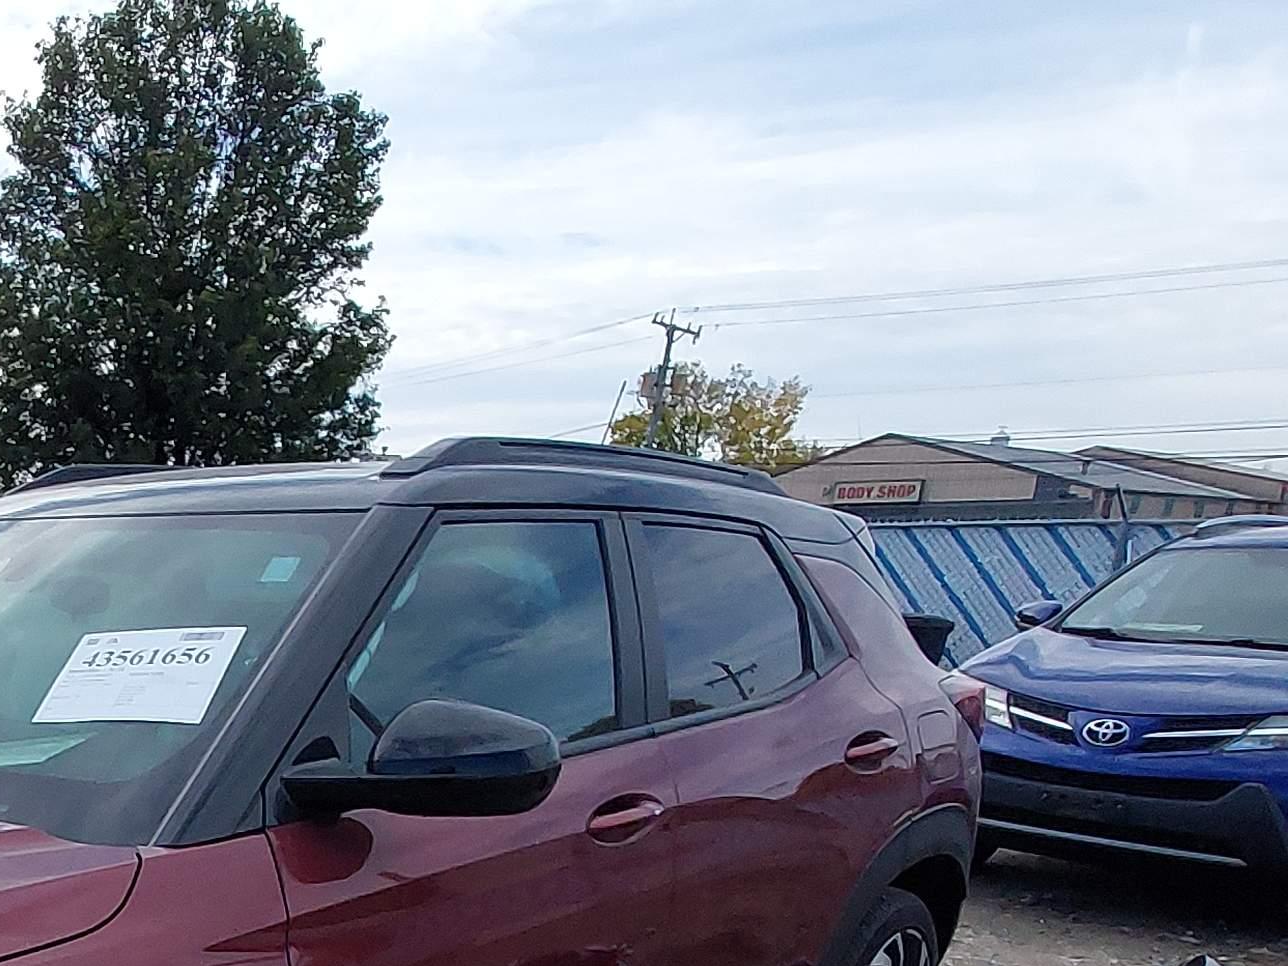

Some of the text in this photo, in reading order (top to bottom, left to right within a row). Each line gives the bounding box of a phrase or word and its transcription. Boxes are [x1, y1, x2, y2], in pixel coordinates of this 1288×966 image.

[837, 486, 873, 499] BODY
[877, 484, 916, 498] SHOP
[82, 647, 214, 667] 43561656
